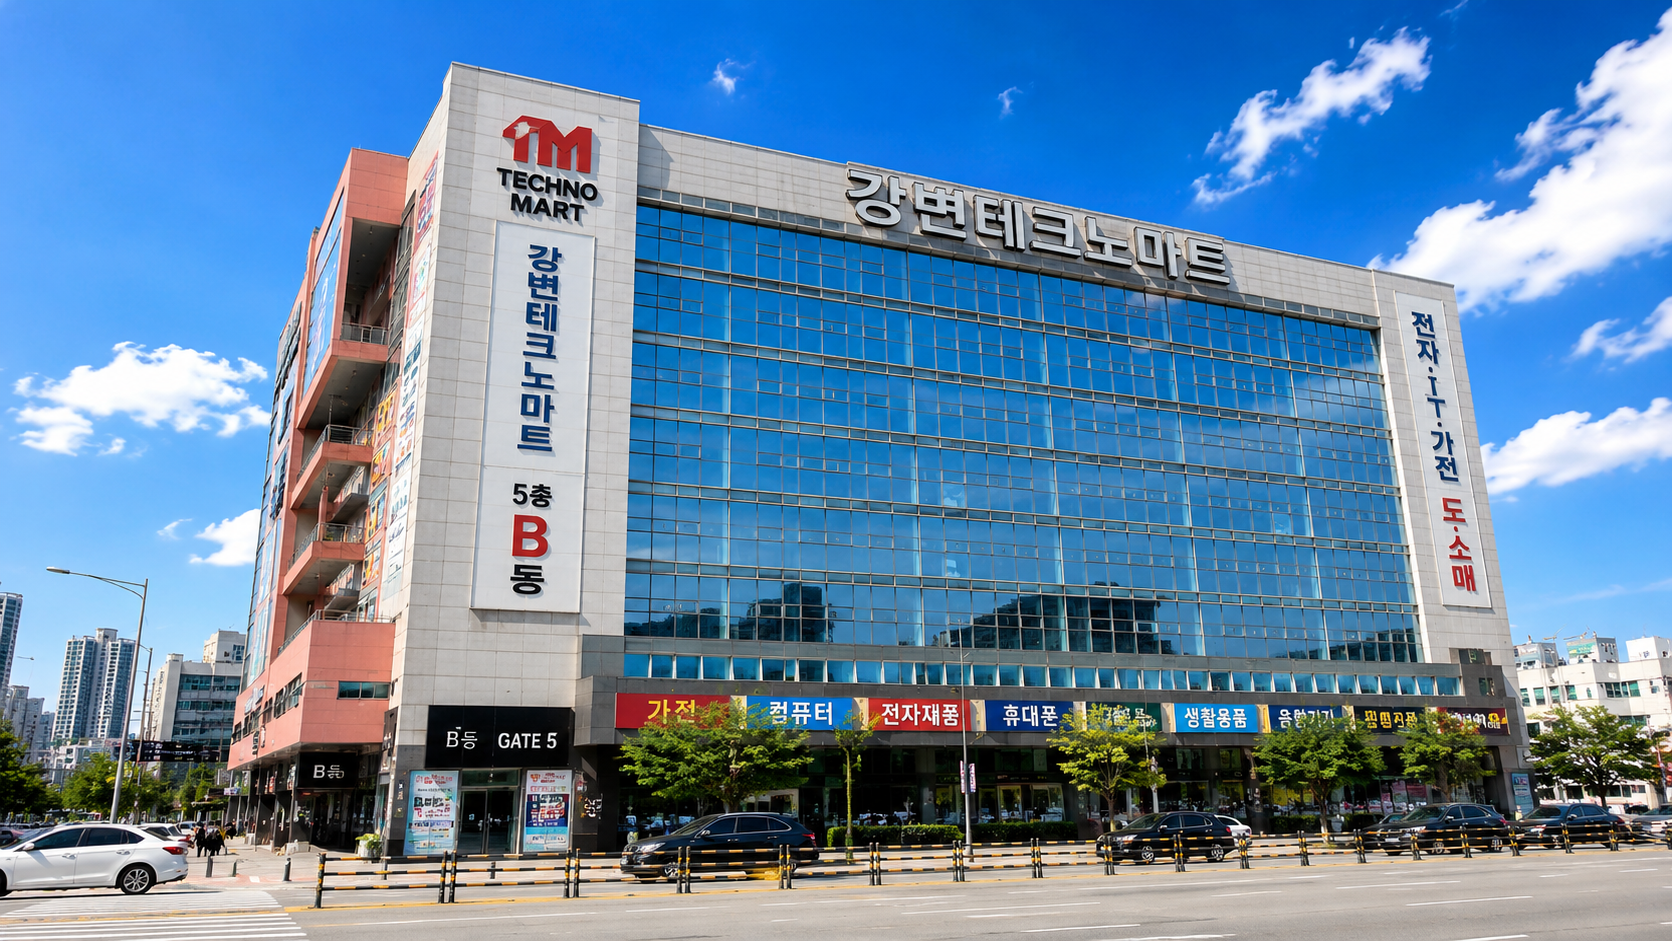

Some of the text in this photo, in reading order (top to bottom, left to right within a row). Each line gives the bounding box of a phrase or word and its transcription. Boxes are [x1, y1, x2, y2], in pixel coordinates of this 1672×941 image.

[496, 167, 598, 201] TECHNO
[510, 193, 584, 222] MART
[846, 168, 1231, 285] 강변테크노마트
[517, 244, 562, 452] 강변테크노마트
[512, 483, 553, 508] 5층
[647, 699, 695, 724] 가전
[769, 701, 833, 726] 컴퓨터
[1003, 704, 1059, 727] 휴대폰
[497, 732, 558, 749] GATE 5
